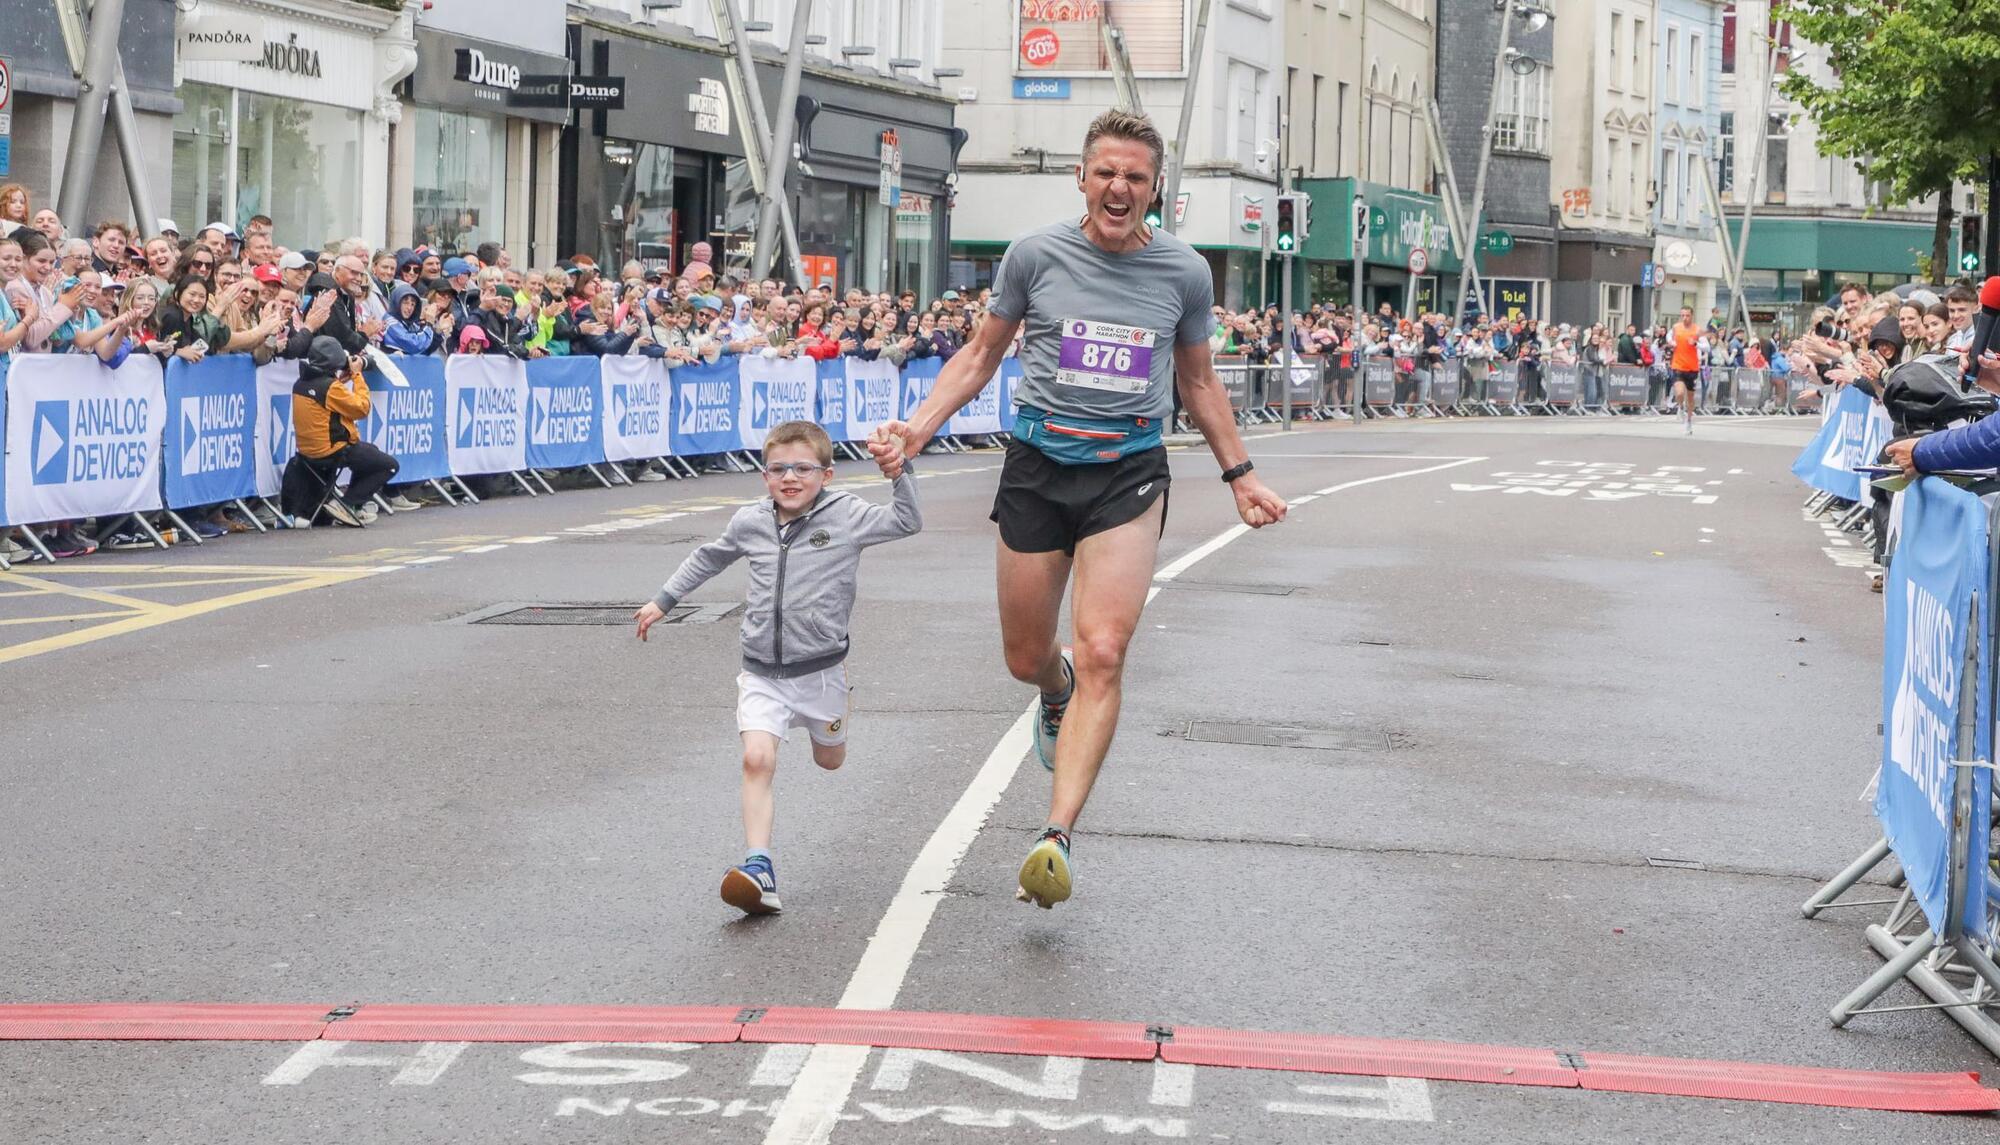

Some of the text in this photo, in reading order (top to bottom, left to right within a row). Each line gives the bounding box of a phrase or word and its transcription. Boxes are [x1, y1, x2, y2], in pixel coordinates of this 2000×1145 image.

[1027, 39, 1056, 60] 60%
[469, 48, 520, 90] Dune
[474, 89, 500, 101] LONDON
[571, 84, 620, 97] Dune
[1024, 82, 1058, 97] global
[1502, 290, 1526, 303] To Let
[1096, 331, 1129, 339] MARATHON
[1082, 343, 1131, 372] 876
[389, 389, 433, 420] ANALOG
[476, 387, 516, 415] ANALOG
[550, 386, 592, 413] ANALOG
[627, 382, 660, 408] ANALOG
[697, 381, 731, 407] ANALOG
[770, 381, 807, 402] ANALOG
[75, 397, 148, 437] ANALOG
[201, 393, 245, 429] ANALOG
[626, 410, 660, 437] DEVICES
[697, 408, 731, 433] DEVICES
[388, 423, 433, 455] DEVICES
[475, 420, 515, 447] DEVICES
[550, 416, 592, 443] DEVICES
[73, 440, 146, 481] DEVICES
[201, 433, 243, 472] DEVICES
[1914, 586, 1953, 709] ANALOG
[260, 1040, 1434, 1122] FINISH
